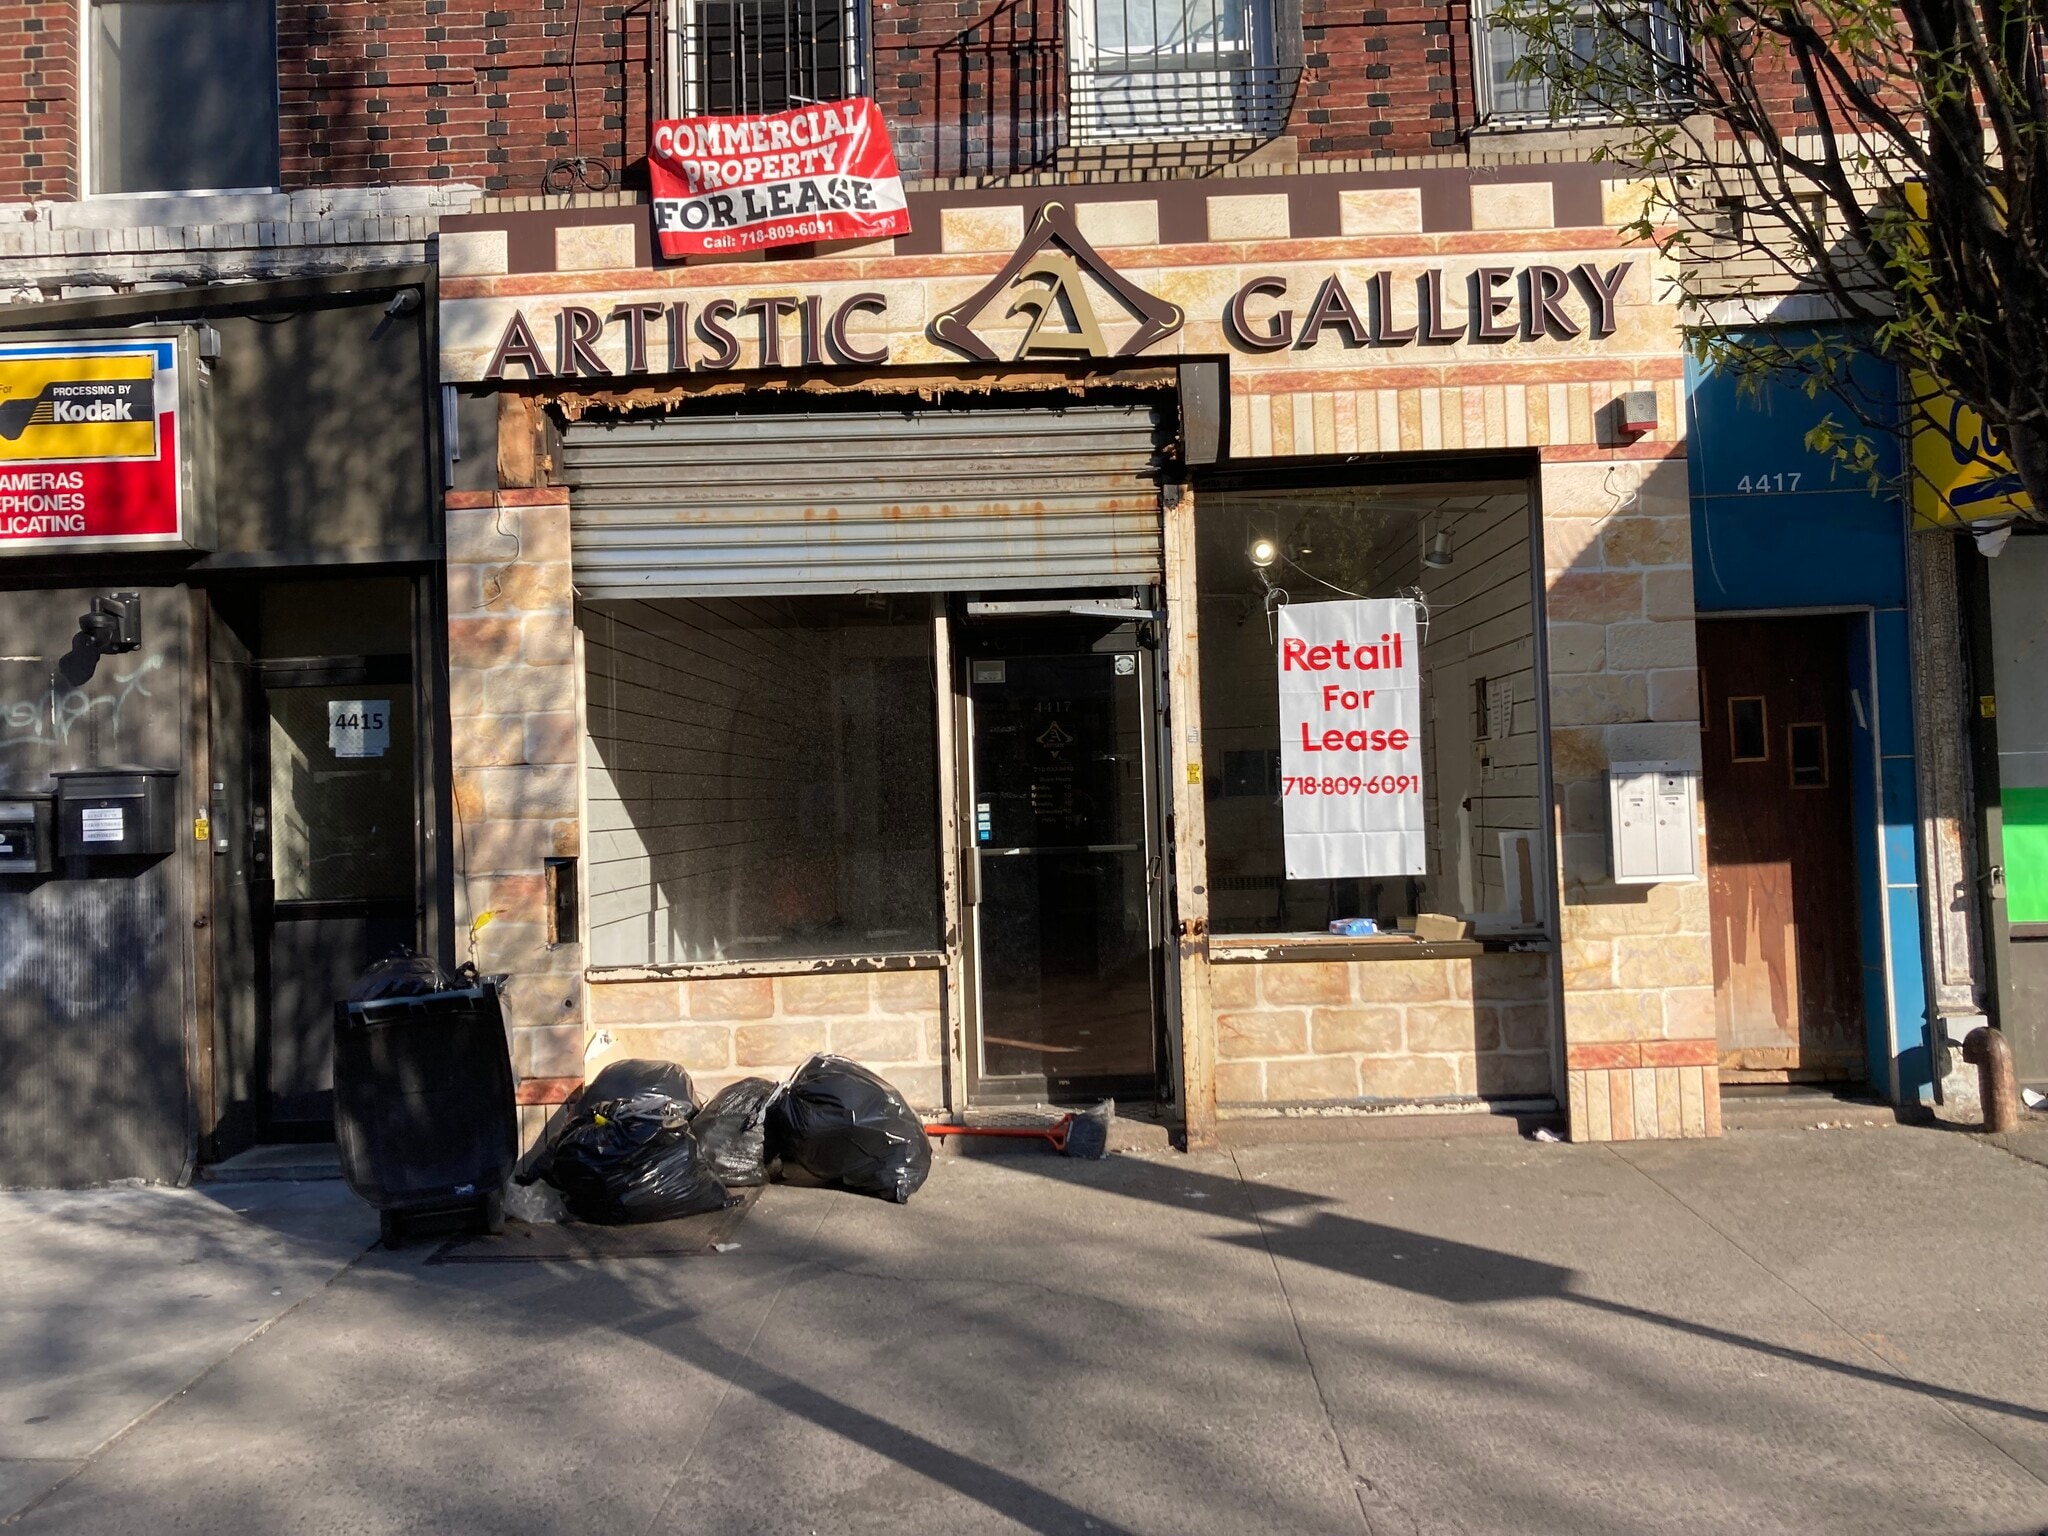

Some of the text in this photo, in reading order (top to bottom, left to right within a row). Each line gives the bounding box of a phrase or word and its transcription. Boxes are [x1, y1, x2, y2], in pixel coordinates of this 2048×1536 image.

[655, 105, 865, 159] COMMERCIAL
[683, 141, 838, 194] PROPERTY
[655, 178, 877, 230] FOR LEASE
[740, 219, 834, 247] 718-809-6091
[1226, 262, 1634, 350] GALLERY
[484, 292, 890, 380] ARTISTIC
[53, 385, 131, 396] PROCESSING BY
[53, 399, 133, 422] Kodak
[1737, 472, 1802, 493] 4417
[1283, 633, 1403, 671] Retail
[1033, 700, 1072, 713] 4417
[1323, 684, 1375, 711] For
[335, 713, 384, 730] 4415
[1301, 722, 1409, 752] Lease
[1283, 776, 1418, 796] 718-809-6091
